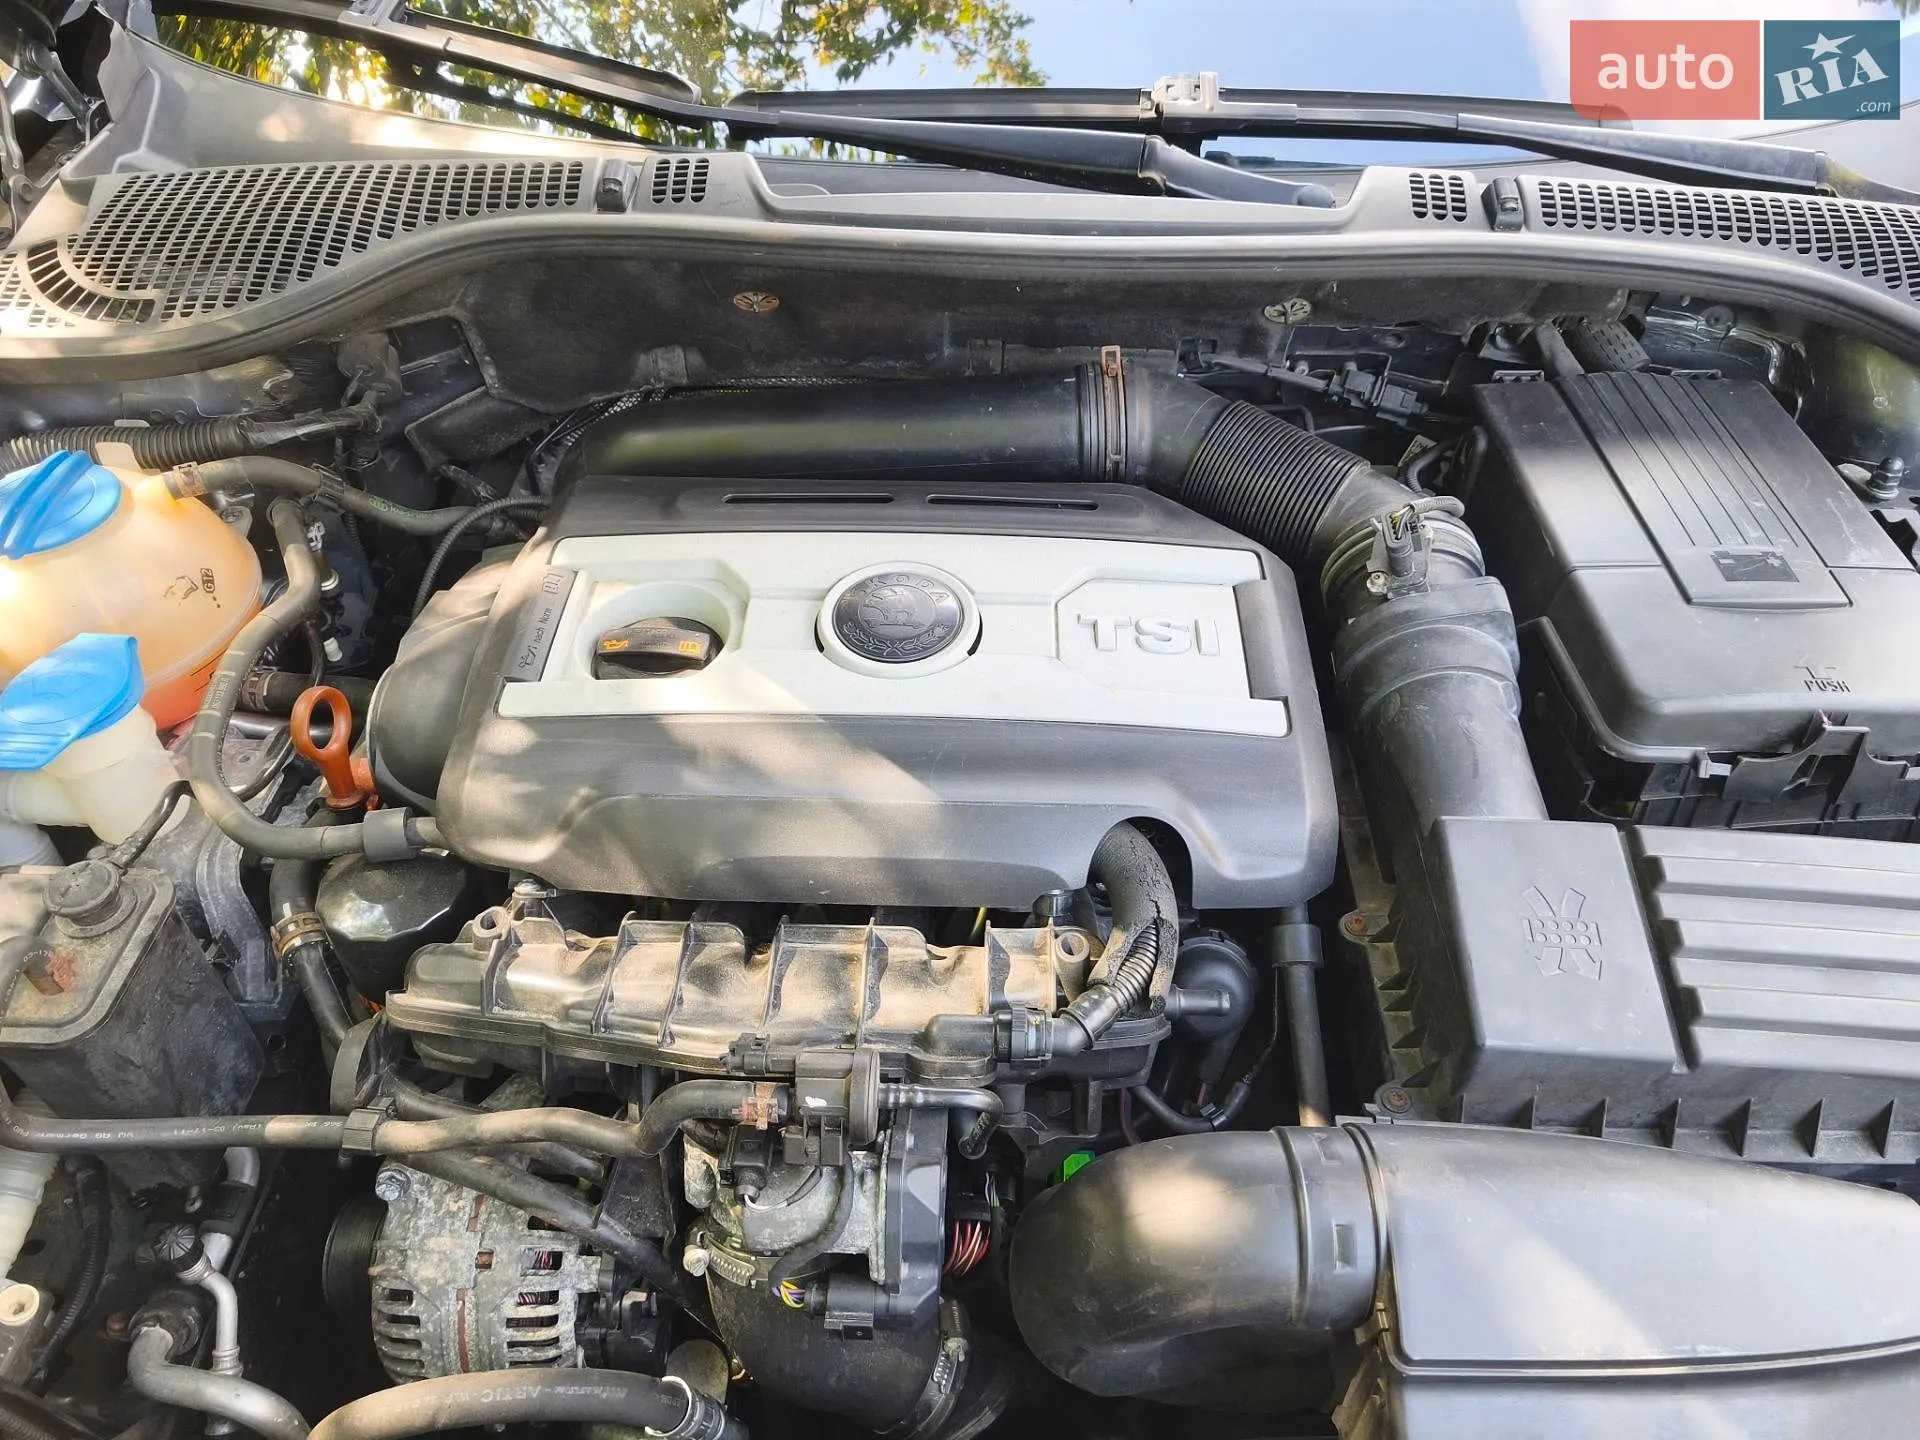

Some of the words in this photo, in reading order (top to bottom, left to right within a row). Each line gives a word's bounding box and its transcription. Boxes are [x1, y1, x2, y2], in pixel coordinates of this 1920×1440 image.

[201, 568, 215, 593] G12
[1077, 604, 1221, 657] TSI
[1803, 679, 1851, 693] PUSH
